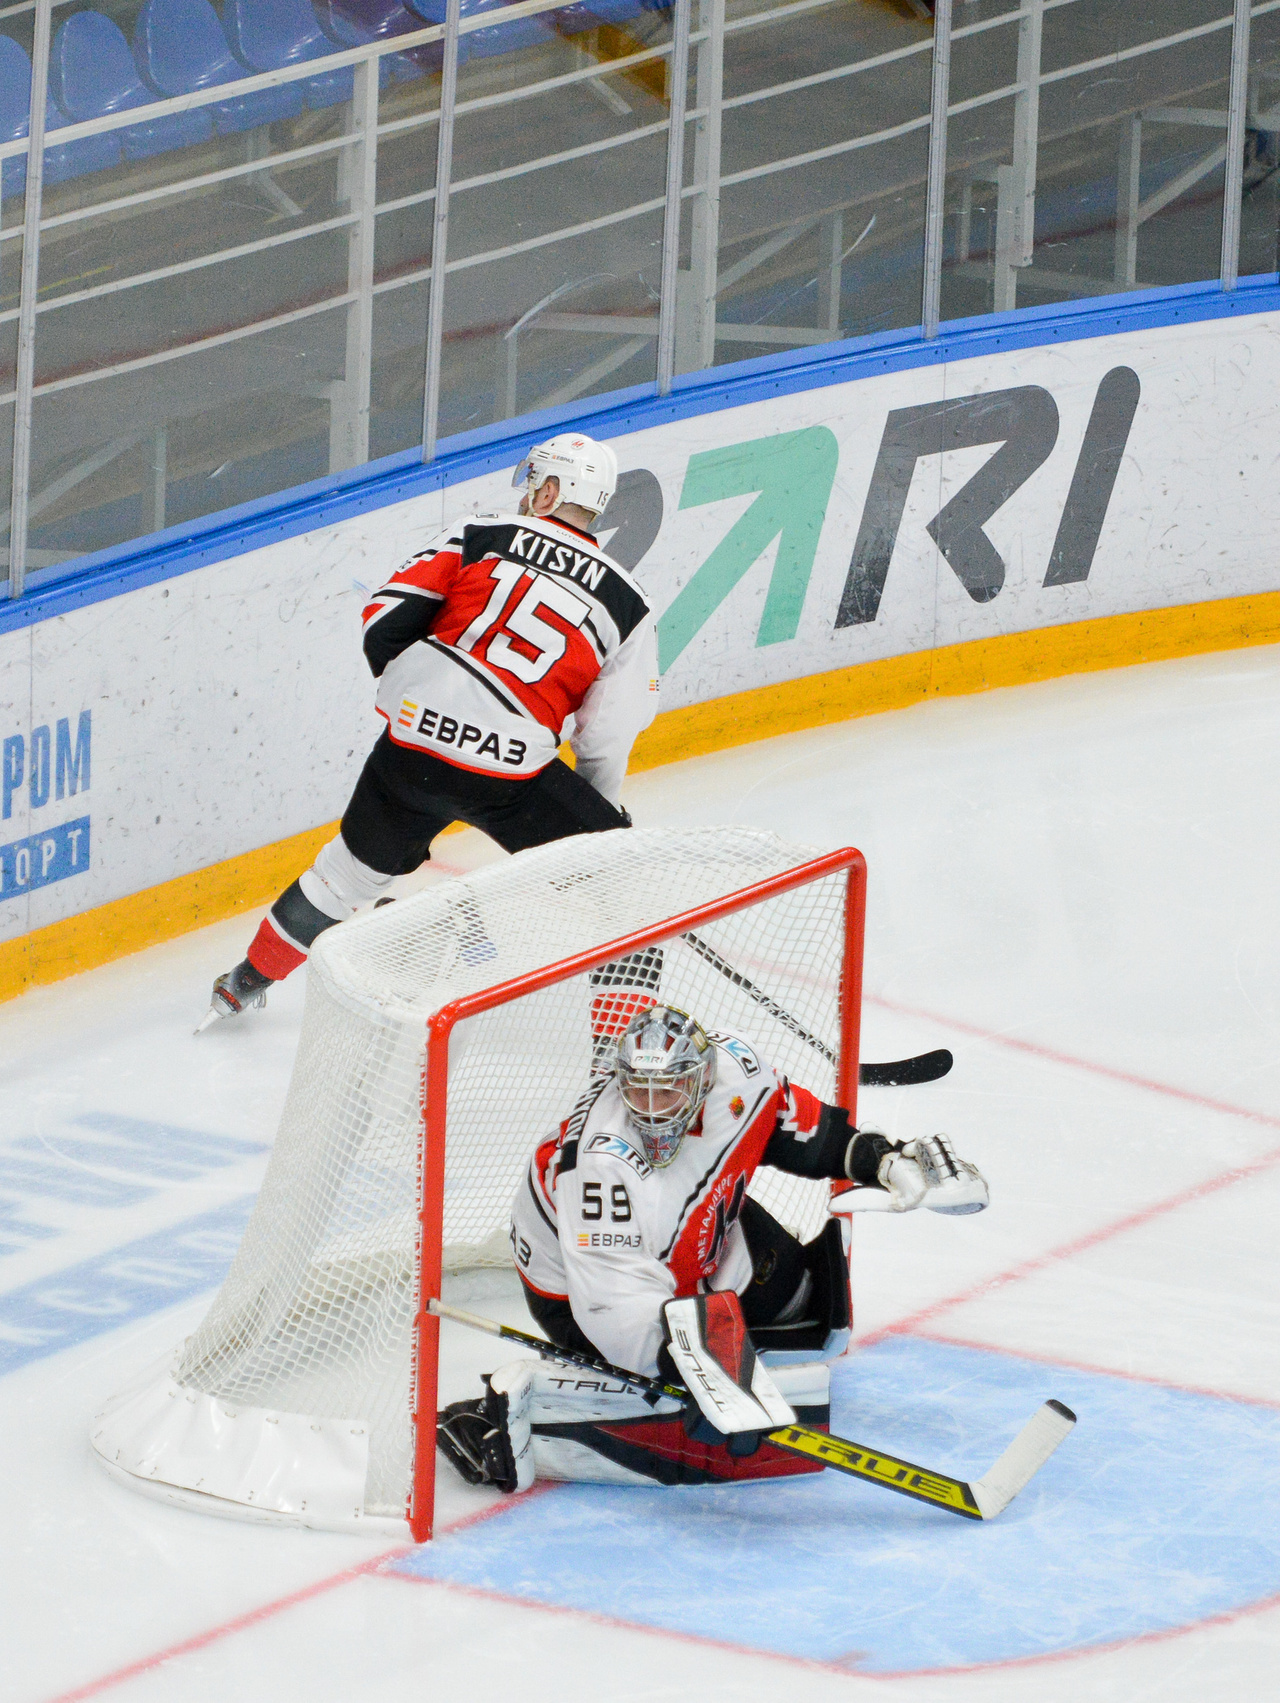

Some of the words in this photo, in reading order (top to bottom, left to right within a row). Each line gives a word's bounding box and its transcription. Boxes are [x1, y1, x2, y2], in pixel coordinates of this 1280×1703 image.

[597, 490, 609, 507] 15
[508, 529, 608, 592] KITSYN
[454, 559, 593, 684] 15
[416, 707, 527, 766] ЕВРАЗ
[634, 1054, 665, 1064] PARI
[587, 1135, 650, 1176] PARI
[581, 1182, 632, 1223] 59
[591, 1233, 642, 1248] ЕВРАЗ
[675, 1327, 726, 1414] TRUE
[786, 1427, 953, 1500] TRUE
